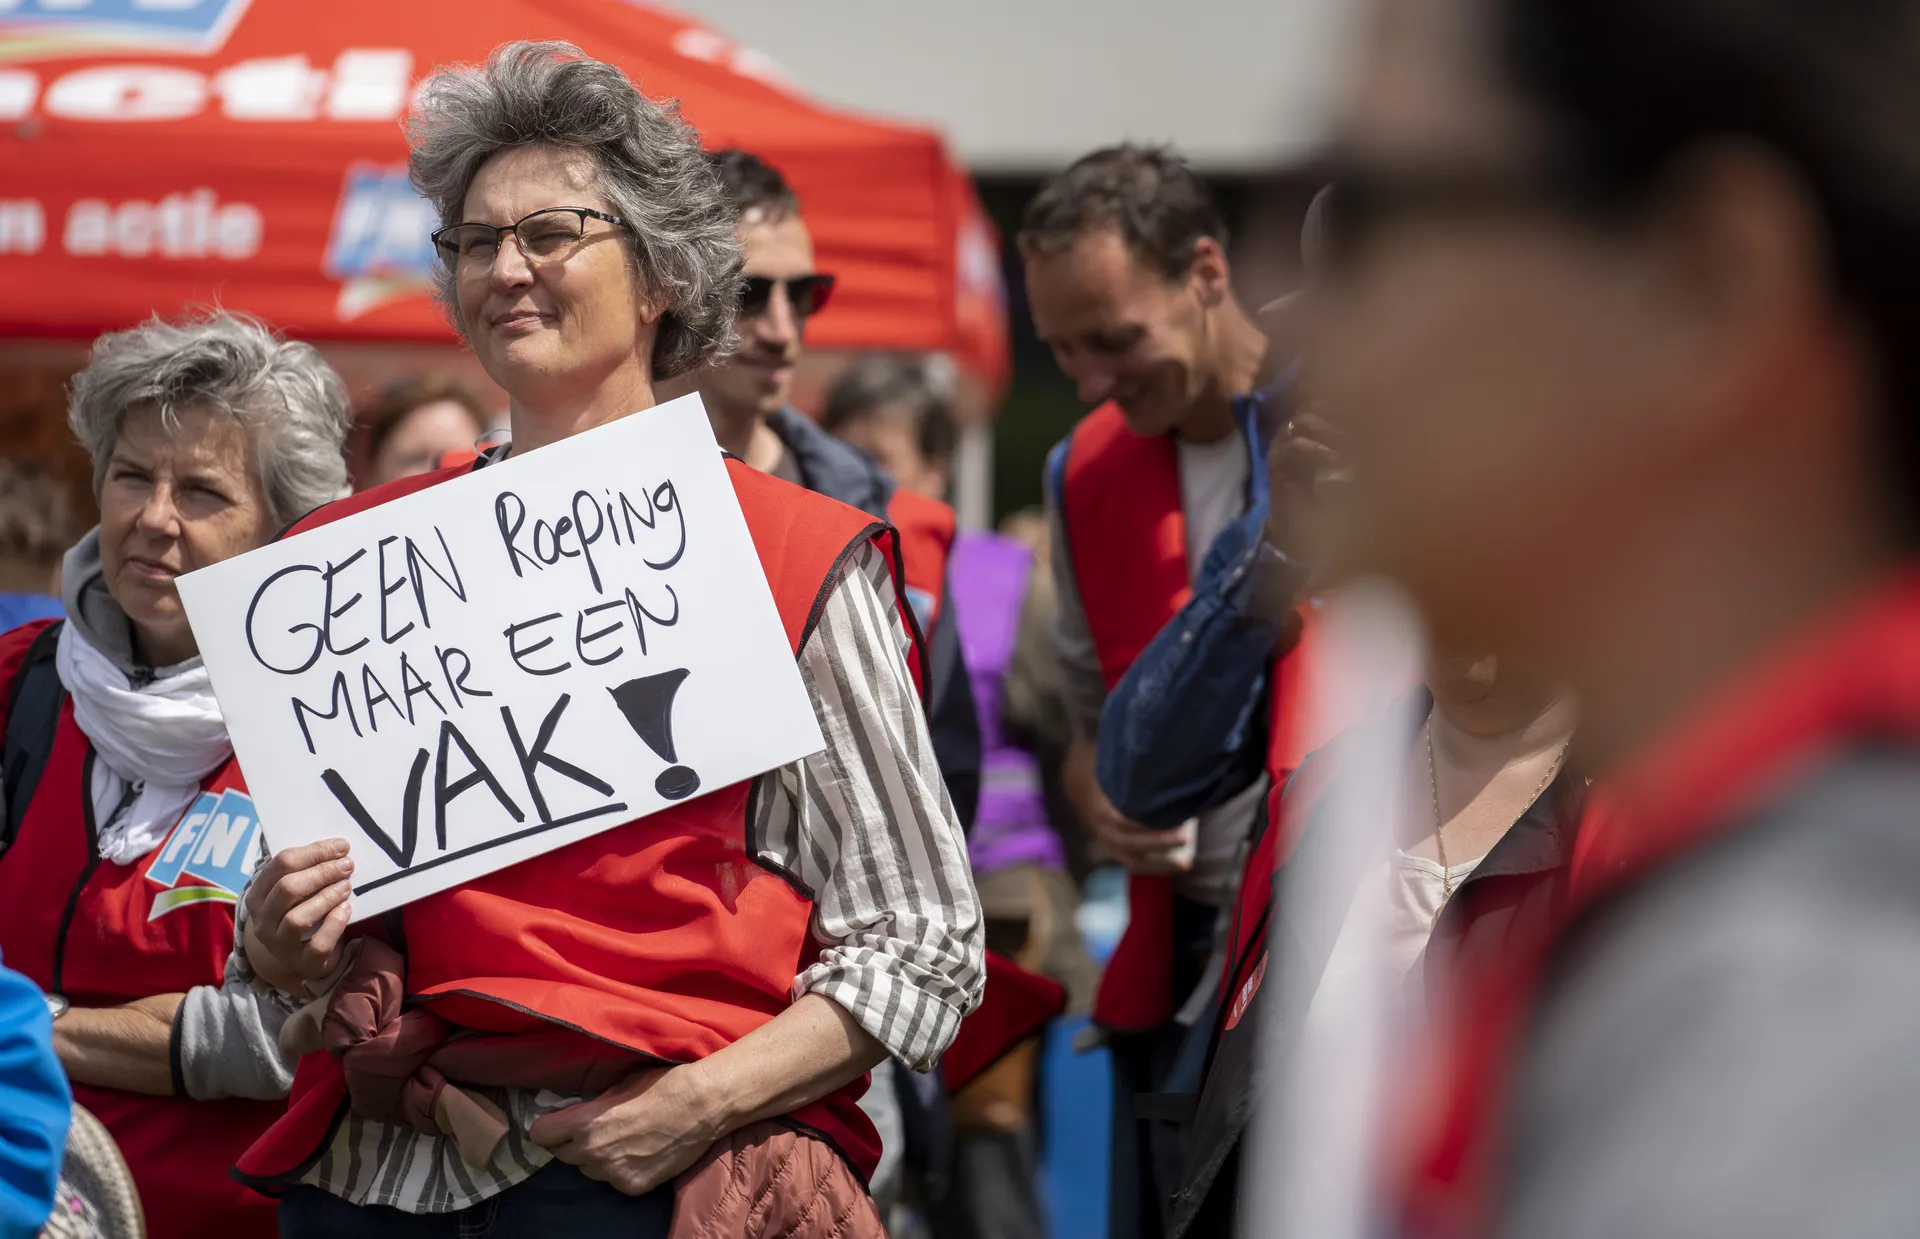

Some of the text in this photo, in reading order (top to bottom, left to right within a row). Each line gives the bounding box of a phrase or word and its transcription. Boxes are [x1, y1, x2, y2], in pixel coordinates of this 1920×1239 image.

[246, 526, 467, 675] GEEN
[292, 584, 679, 755] MAAR EEN
[321, 668, 701, 869] VAK!
